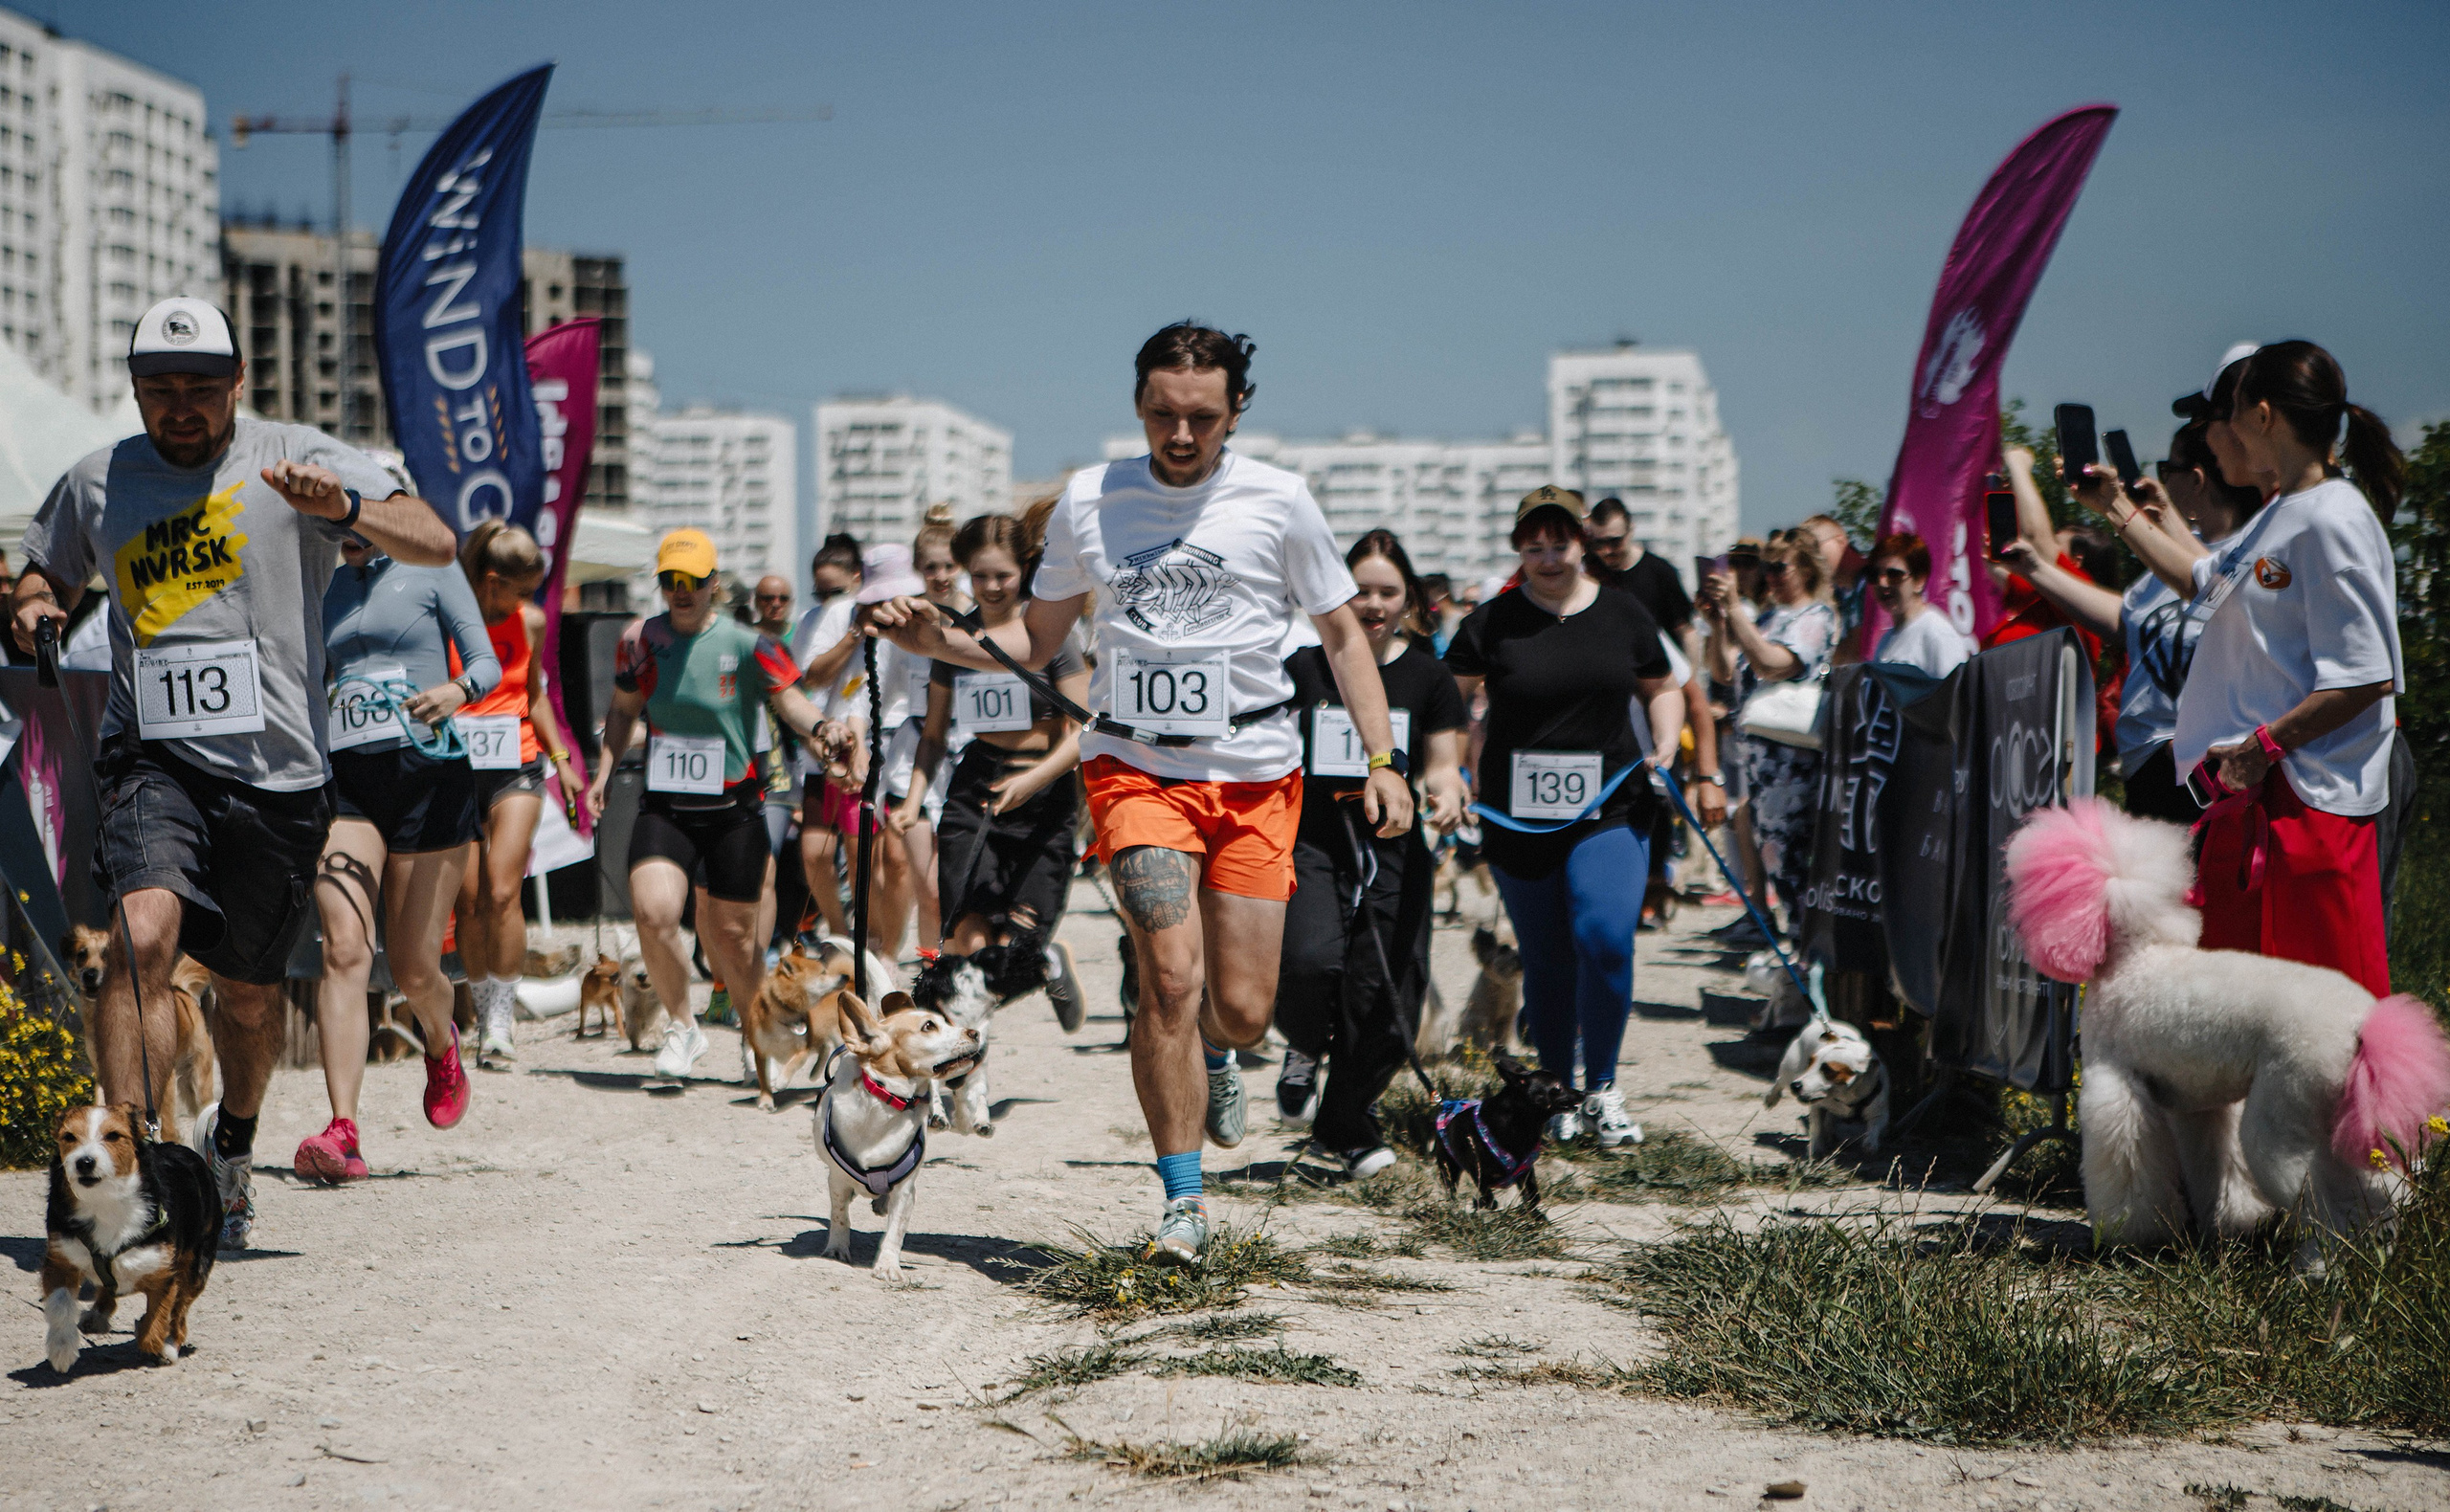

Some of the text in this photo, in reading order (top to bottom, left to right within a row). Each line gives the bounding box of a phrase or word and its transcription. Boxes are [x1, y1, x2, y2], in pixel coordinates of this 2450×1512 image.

[455, 398, 493, 462] TO
[458, 470, 513, 533] G
[145, 509, 211, 552] MRC
[130, 536, 233, 590] NVRSK
[1183, 545, 1220, 566] RUNNING
[1129, 611, 1148, 631] CLUB
[159, 666, 231, 716] 113
[971, 689, 1013, 718] 101
[1130, 670, 1208, 715] 103
[1342, 728, 1365, 761] 11
[667, 752, 707, 781] 110
[1527, 772, 1586, 804] 139
